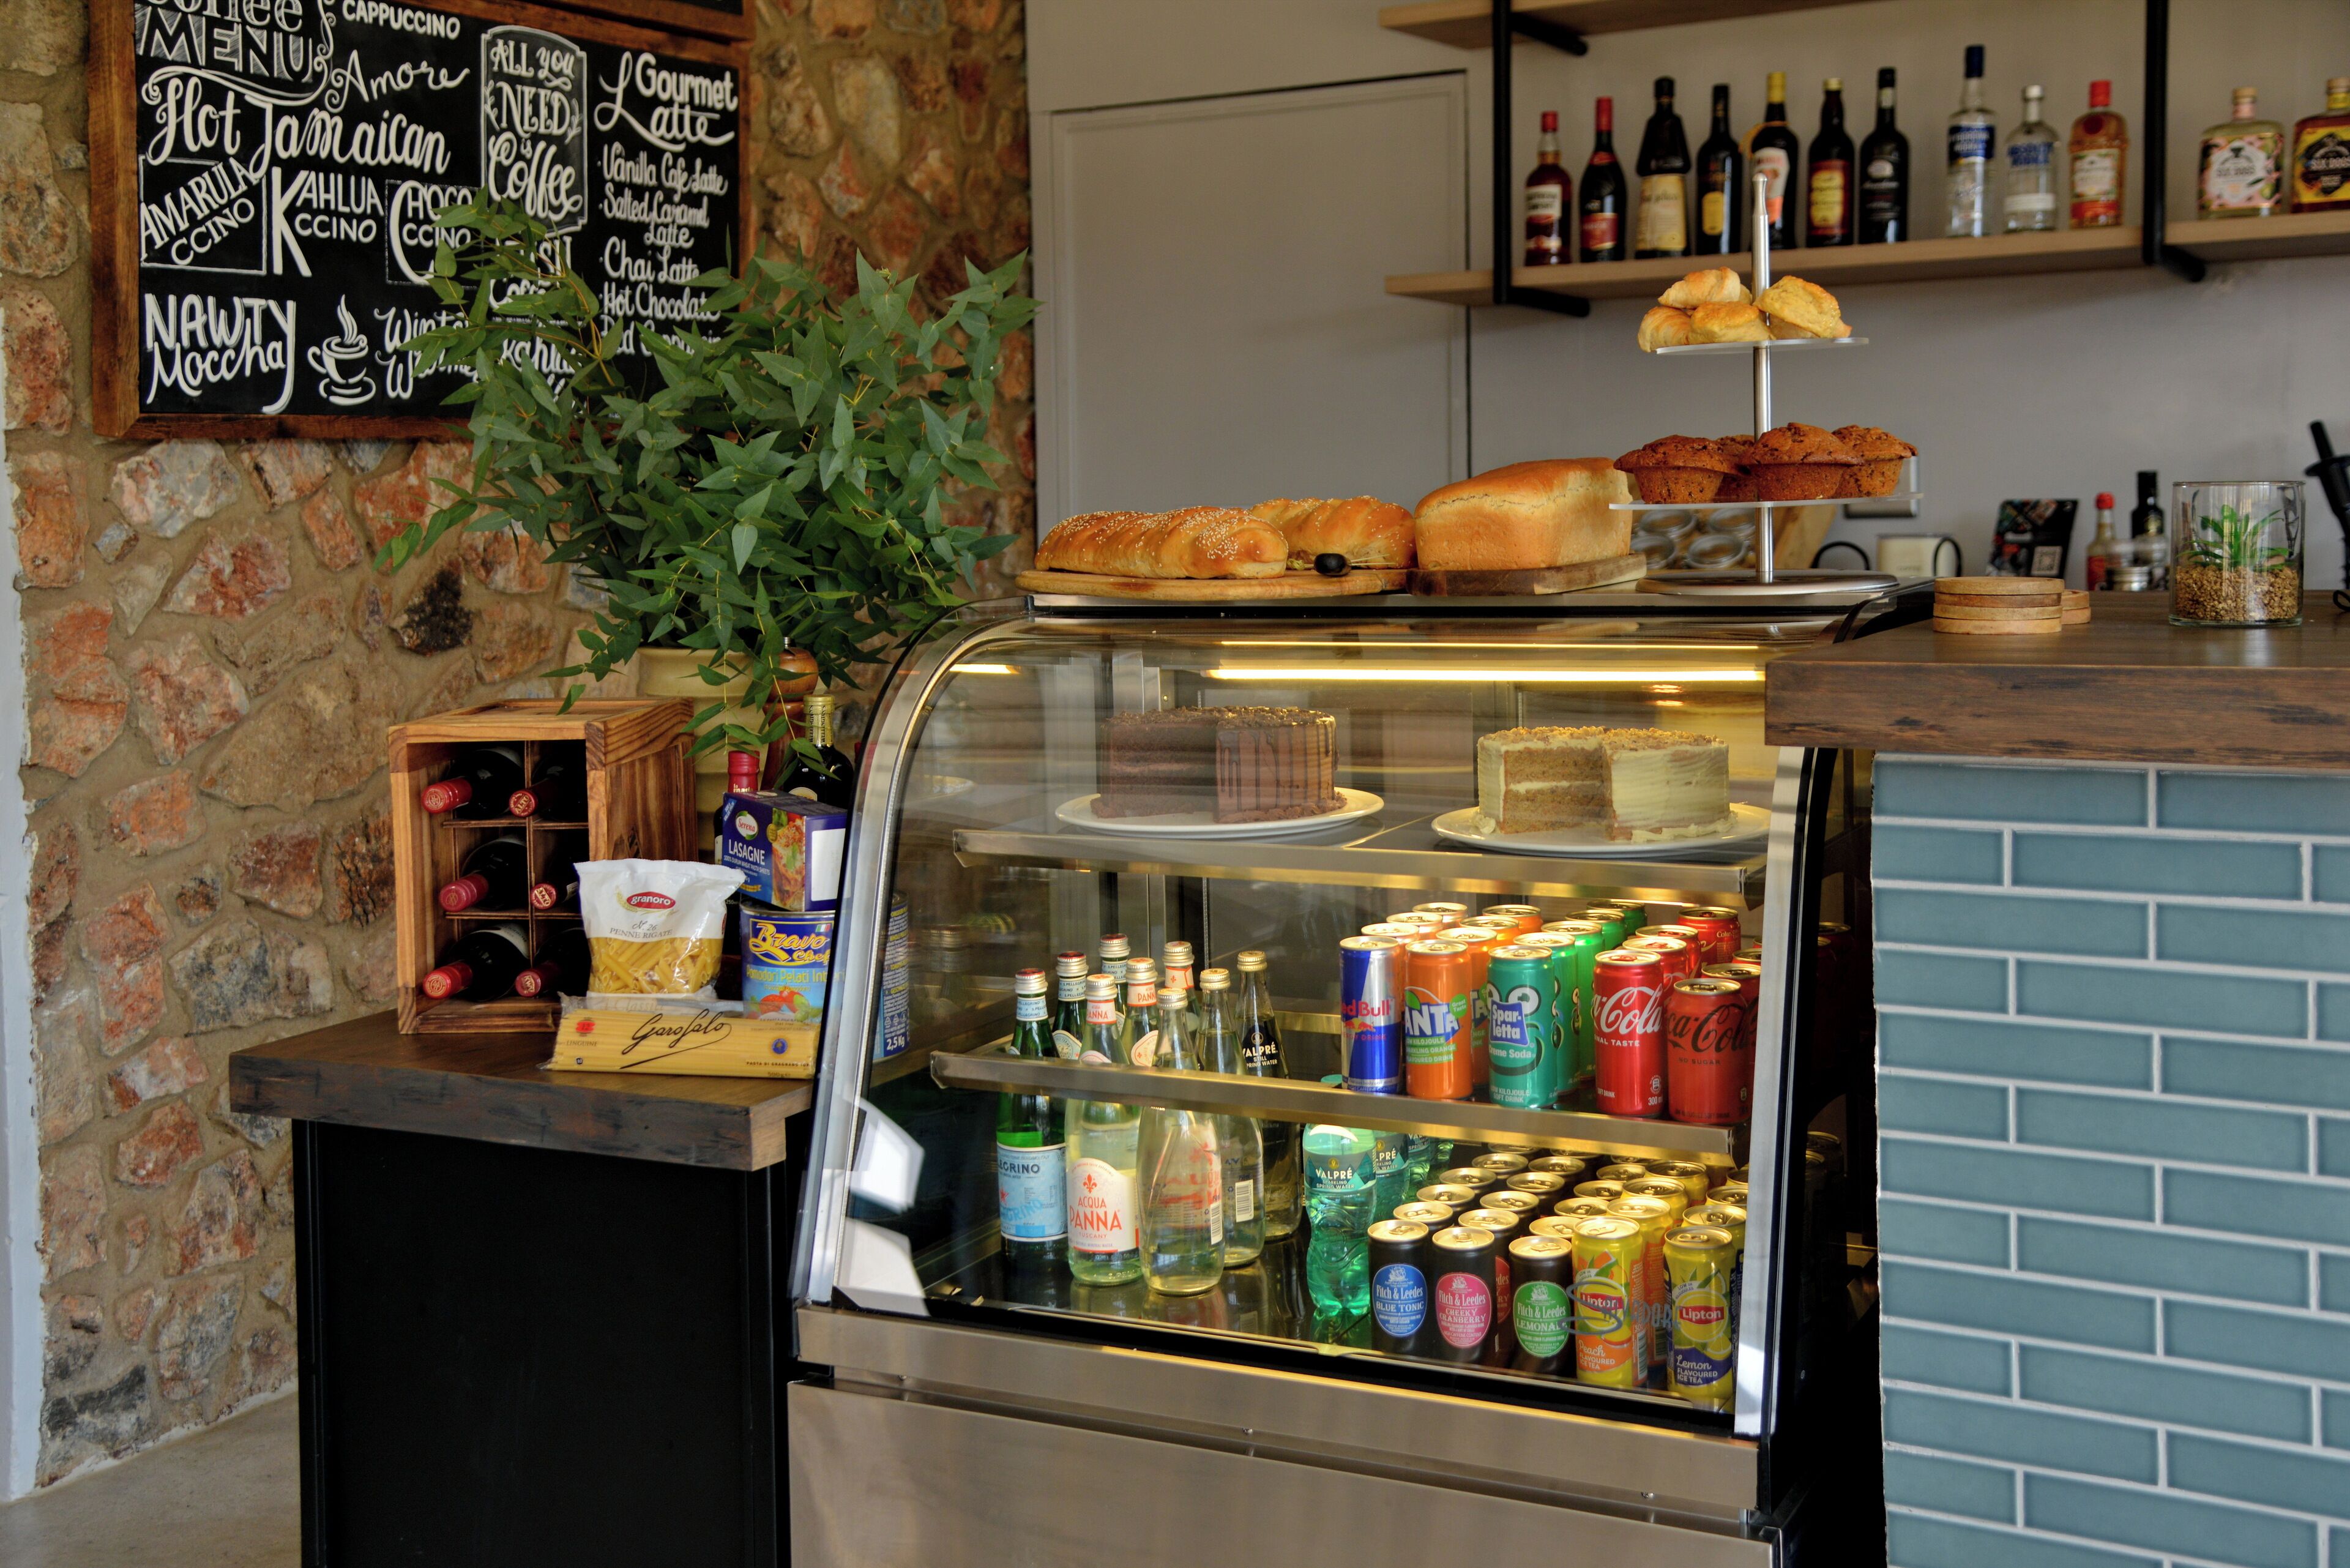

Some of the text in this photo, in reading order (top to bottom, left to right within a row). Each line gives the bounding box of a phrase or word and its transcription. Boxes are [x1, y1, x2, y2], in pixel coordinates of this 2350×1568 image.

[343, 0, 461, 39] CAPPUCCINO
[135, 4, 314, 83] MENU
[490, 39, 576, 92] ALL you
[326, 50, 470, 113] Amore
[635, 52, 739, 112] Gourmet
[496, 81, 572, 140] NEED
[147, 77, 241, 165] Hot
[245, 94, 451, 179] Jamaican
[520, 138, 532, 160] is
[488, 131, 583, 223] Coffee
[602, 141, 658, 187] Vanilla
[690, 157, 729, 196] Latte
[140, 157, 261, 261] AMARULA
[603, 182, 652, 223] Salted
[272, 166, 384, 278] KAHLUA
[294, 213, 377, 243] CCINO
[644, 212, 695, 249] Latte
[171, 198, 255, 266] CCINO
[603, 236, 655, 282] Chai
[603, 281, 635, 318] Hot
[144, 293, 296, 415] NAWTY
[146, 318, 288, 405] Moccha
[738, 818, 756, 833] Serena
[728, 838, 765, 865] LASAGNE
[631, 895, 671, 906] granoro
[609, 927, 673, 938] PENNE RIGATE
[749, 922, 830, 962] Bravo
[747, 964, 810, 983] Pomodori Pelati
[1137, 992, 1156, 1003] PANN
[1358, 999, 1390, 1017] Bull
[1491, 1004, 1522, 1025] Spar-
[621, 1009, 733, 1058] Garofalo
[1413, 1036, 1445, 1045] KILOJOULE
[1493, 1024, 1521, 1039] letta
[1430, 1044, 1457, 1053] ORANGE
[1509, 1047, 1532, 1058] Soda
[1603, 1089, 1615, 1098] DRINK
[1648, 1097, 1658, 1106] 300
[999, 1159, 1040, 1174] EGRINO
[1315, 1167, 1353, 1179] VALPRÉ
[1078, 1196, 1106, 1209] ACQUA
[1069, 1204, 1122, 1231] PANNA
[1376, 1285, 1423, 1300] Fitch & Leedes
[1439, 1290, 1453, 1305] Fitch
[1454, 1294, 1461, 1306] &
[1462, 1293, 1486, 1307] Leedes
[1376, 1301, 1424, 1312] BLUE TONIC
[1445, 1307, 1478, 1316] CHEEKY
[1517, 1302, 1534, 1318] Fitch
[1534, 1305, 1541, 1318] &
[1542, 1304, 1566, 1319] Leedes
[1682, 1309, 1721, 1320] Lipton
[1439, 1313, 1486, 1323] CRANBERRY
[1578, 1339, 1606, 1357] Peach
[1579, 1351, 1616, 1365] FLAVOURED
[1588, 1361, 1600, 1370] TEA
[1676, 1354, 1712, 1370] Lemon
[1677, 1367, 1718, 1377] FLAVOURED
